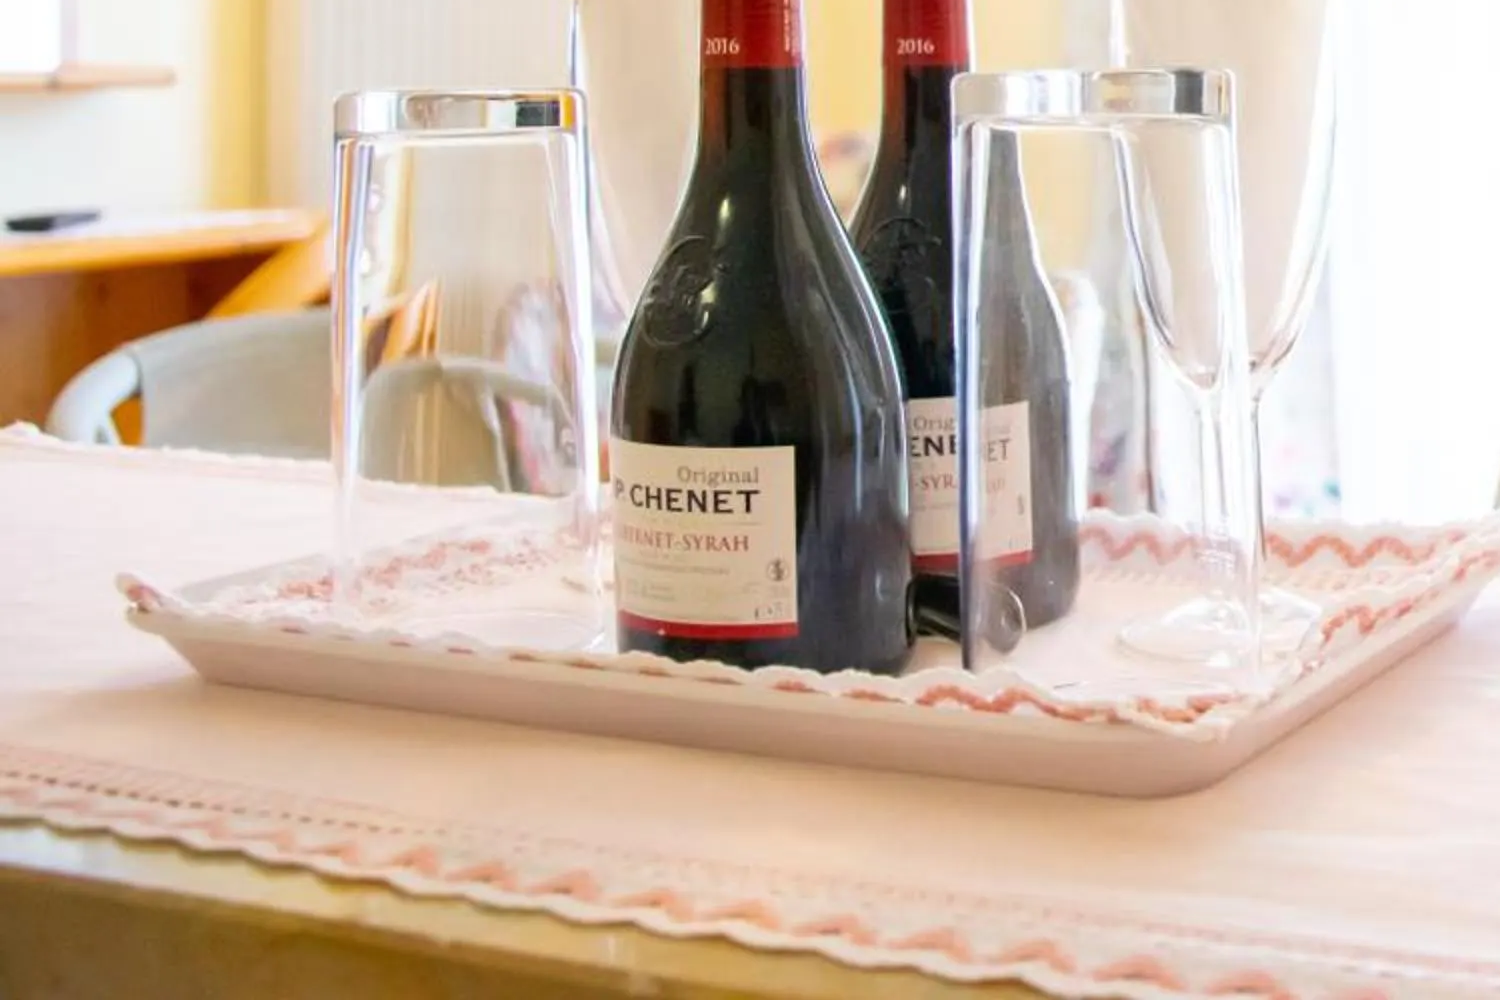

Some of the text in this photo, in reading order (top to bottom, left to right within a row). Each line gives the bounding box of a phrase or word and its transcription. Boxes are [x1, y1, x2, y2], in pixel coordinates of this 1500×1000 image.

[704, 37, 740, 55] 2016
[896, 38, 935, 55] 2016
[677, 465, 759, 487] Original
[629, 484, 761, 514] CHENET
